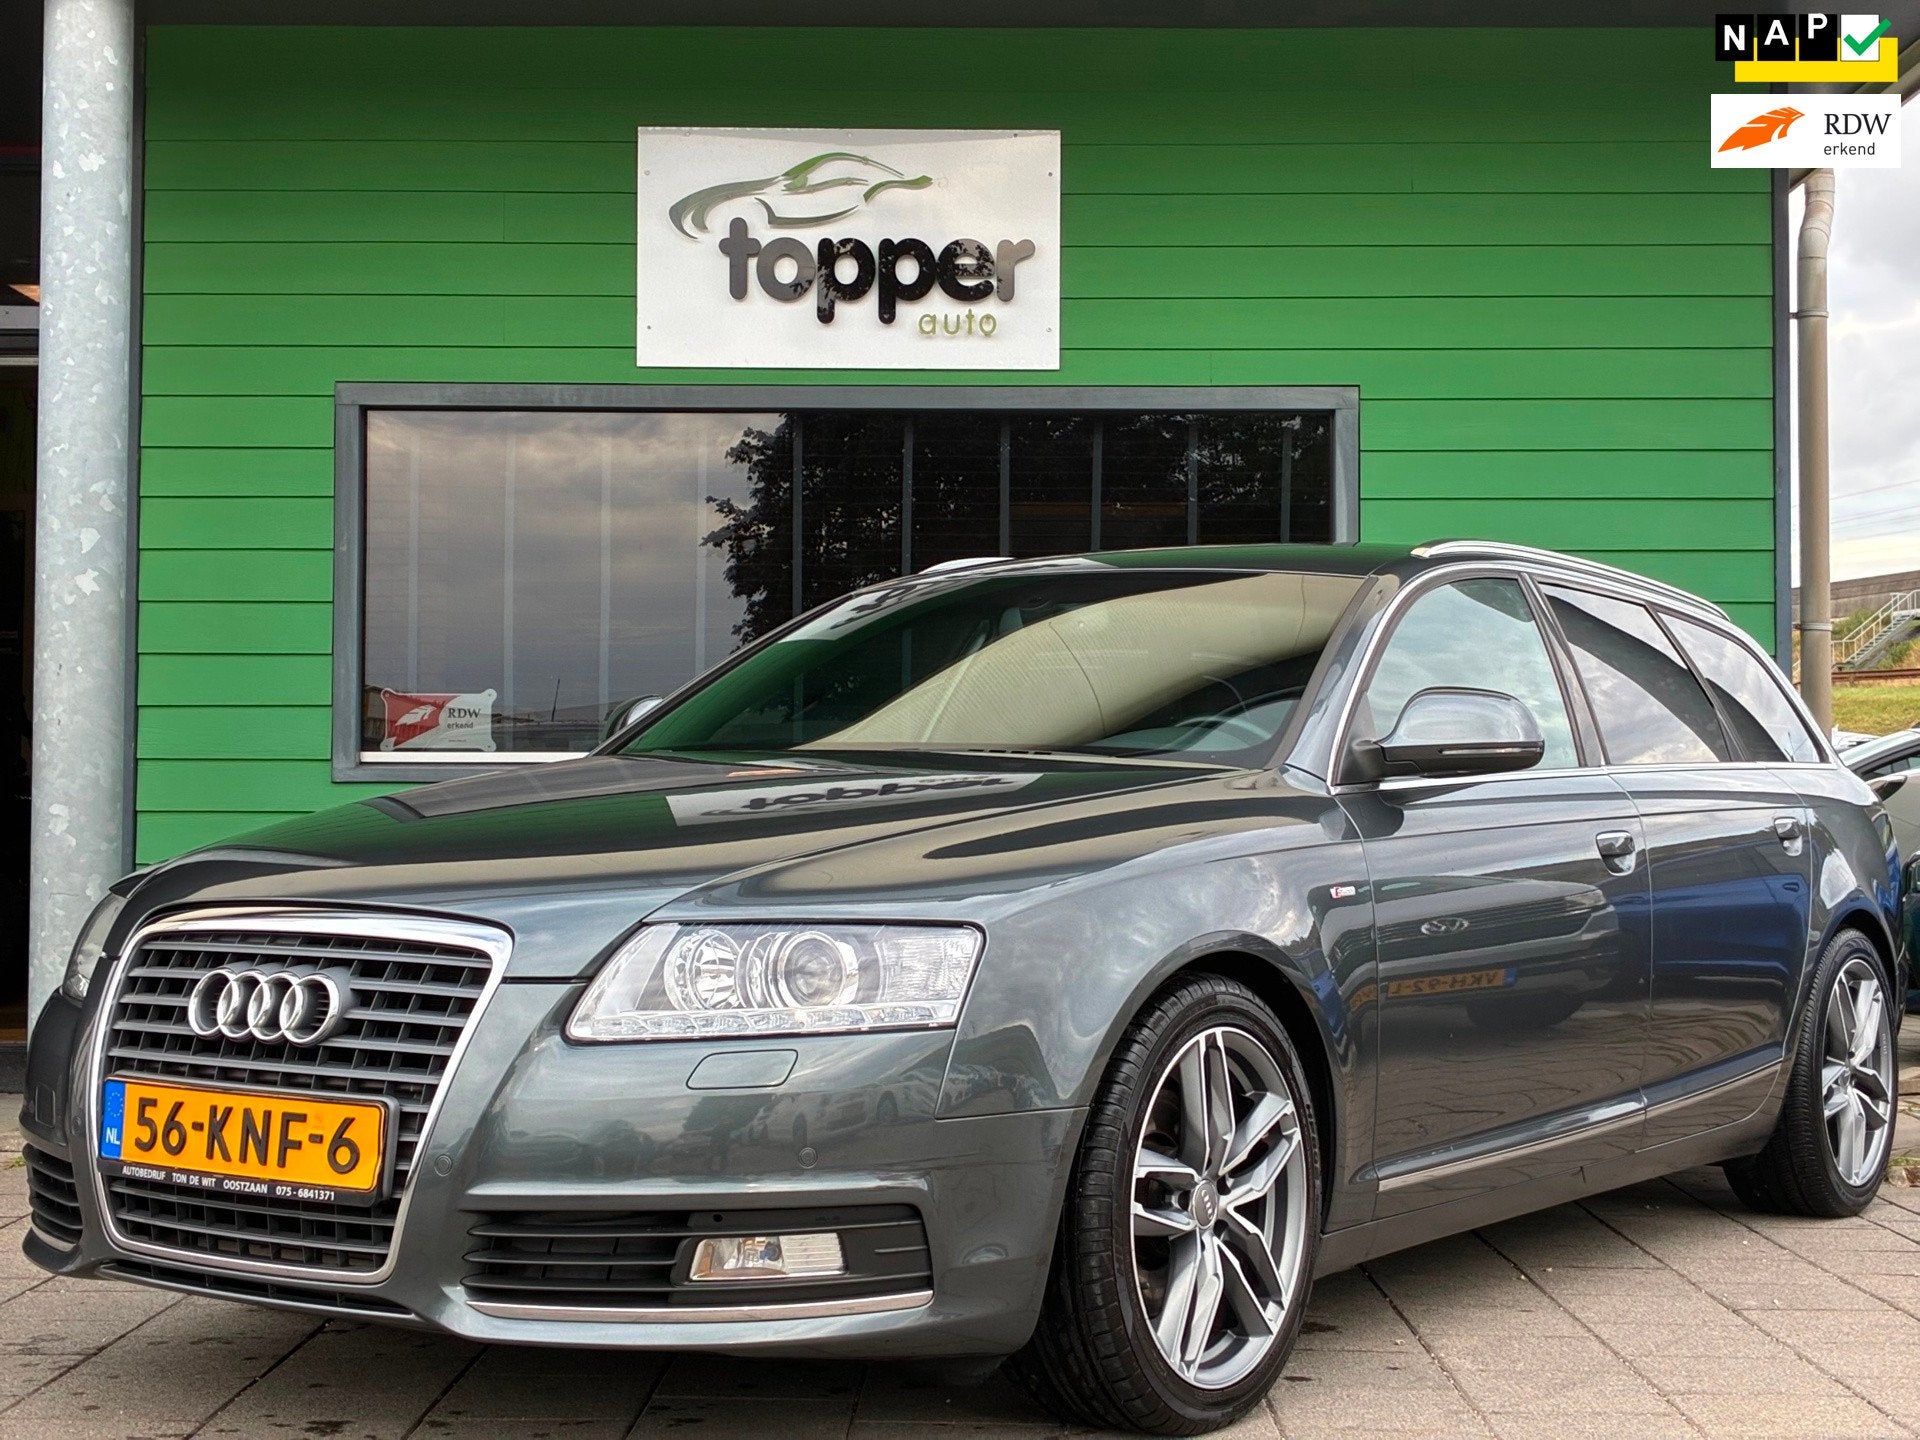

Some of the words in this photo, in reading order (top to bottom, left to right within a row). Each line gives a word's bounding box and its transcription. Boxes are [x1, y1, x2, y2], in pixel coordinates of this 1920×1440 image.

[718, 216, 1036, 325] topper
[918, 308, 998, 337] auto
[446, 721, 474, 730] erkend
[447, 707, 481, 719] RDW
[105, 1126, 121, 1146] NL
[134, 1096, 361, 1175] 56-KNF-6
[122, 1165, 167, 1180] AUTOBEDRIJF
[172, 1172, 187, 1184] TON
[189, 1175, 199, 1185] DE
[201, 1177, 217, 1188] WIT
[223, 1180, 268, 1194] OOSTZAAN
